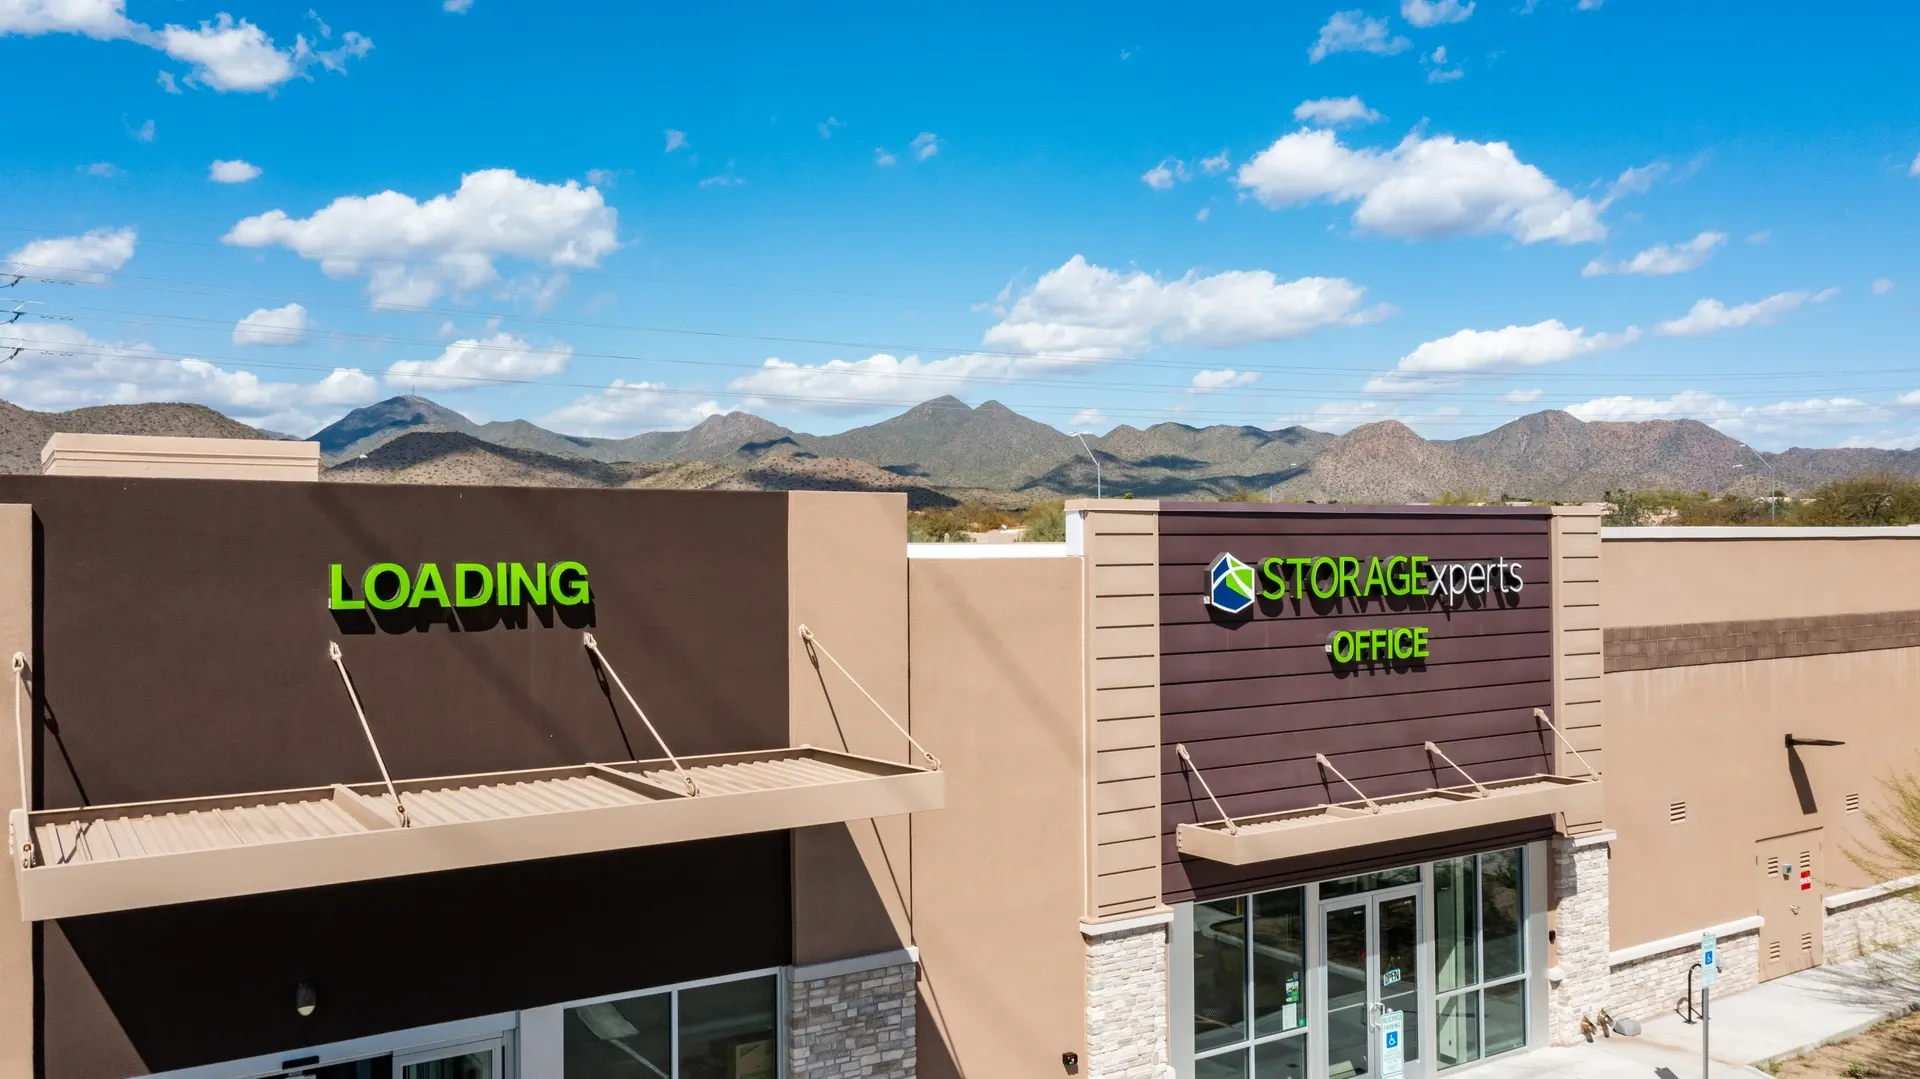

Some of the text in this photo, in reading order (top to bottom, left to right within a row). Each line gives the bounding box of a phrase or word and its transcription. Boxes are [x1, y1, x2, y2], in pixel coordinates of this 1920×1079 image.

[330, 561, 590, 610] LOADING
[1332, 627, 1430, 664] OFFICE
[1384, 970, 1400, 985] OPEN
